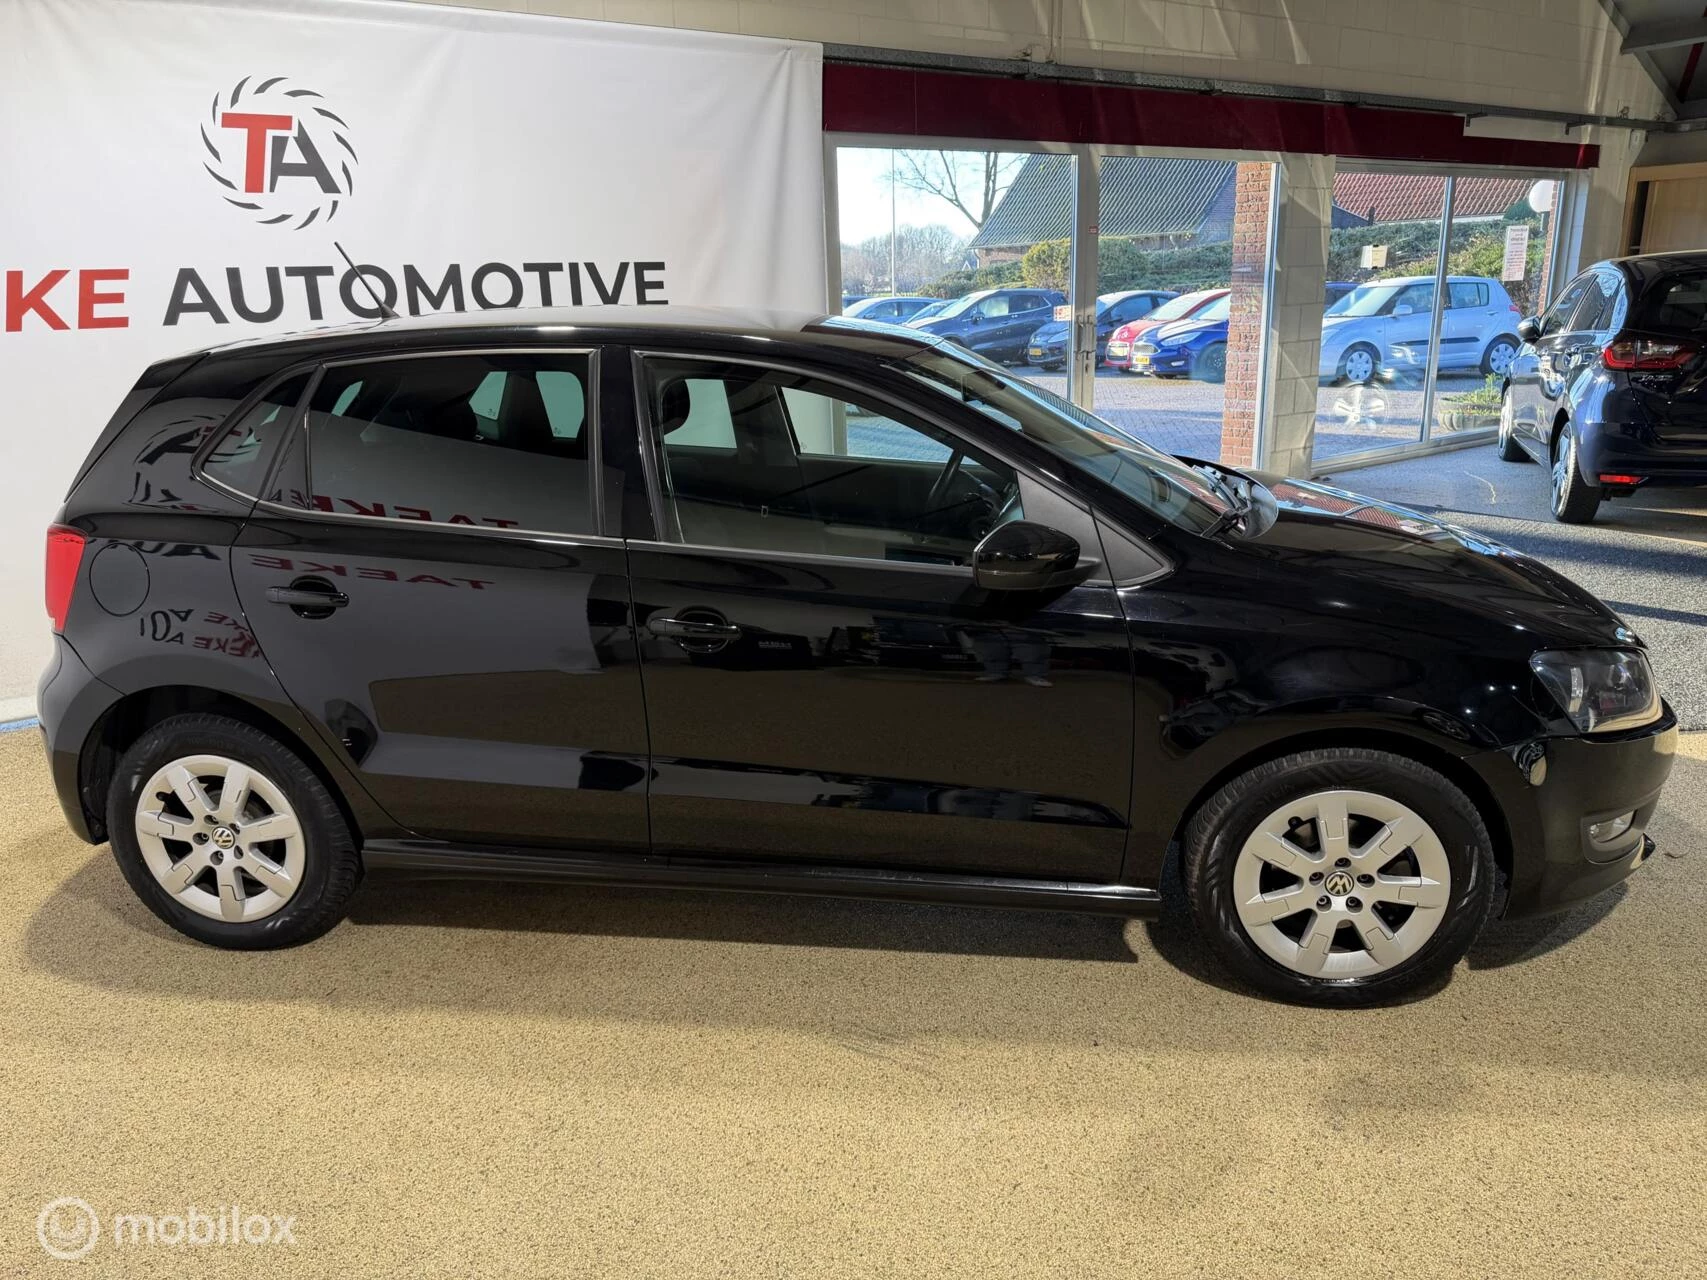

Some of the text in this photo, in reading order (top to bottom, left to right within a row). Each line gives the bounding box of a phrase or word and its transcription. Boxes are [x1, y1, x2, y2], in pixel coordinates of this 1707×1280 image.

[221, 112, 341, 194] TA
[6, 261, 669, 332] KE AUTOMOTIVE
